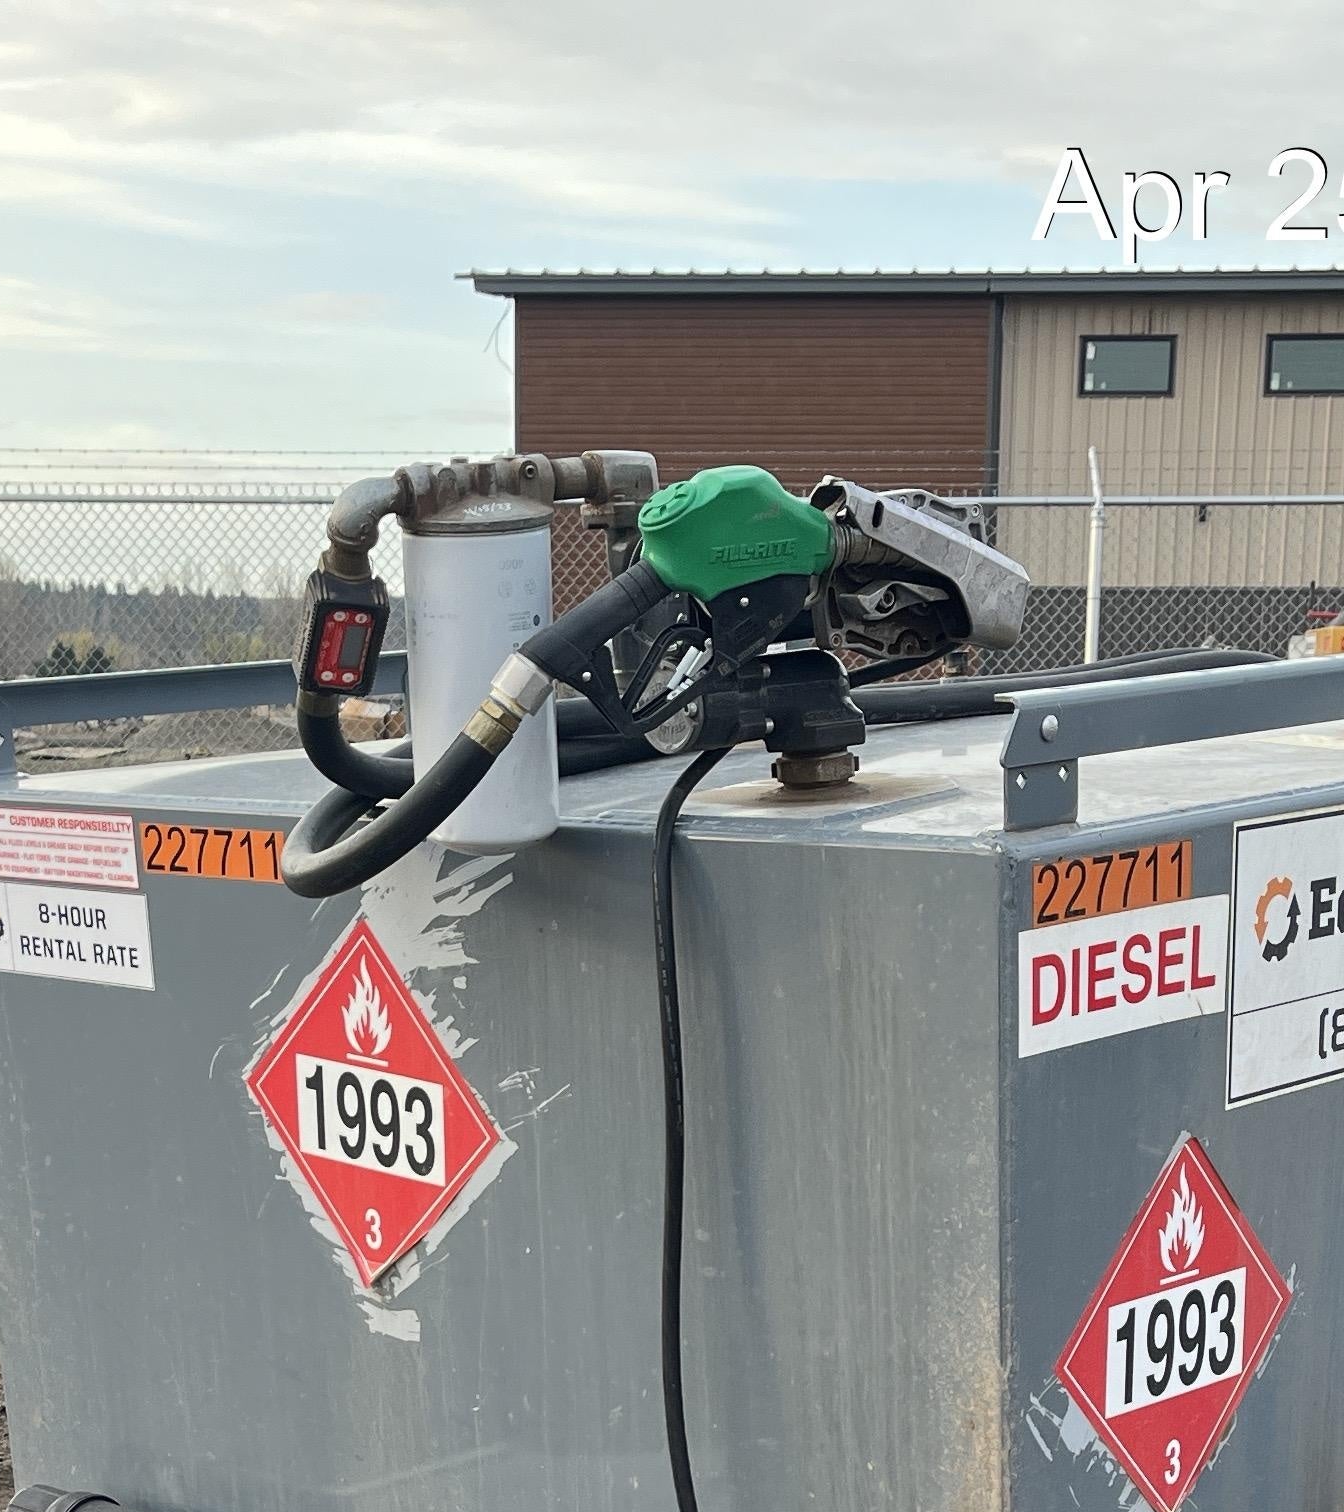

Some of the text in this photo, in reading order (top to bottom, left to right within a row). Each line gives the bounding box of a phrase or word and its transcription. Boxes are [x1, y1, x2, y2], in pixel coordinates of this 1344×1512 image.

[9, 815, 56, 828] CUSTOMER
[57, 818, 132, 834] RESPONSIBILITY
[144, 824, 280, 880] 227711
[1037, 841, 1184, 924] 227711
[38, 902, 107, 930] 8-HOUR
[19, 935, 139, 968] RENTAL RATE
[1032, 925, 1216, 1026] DIESEL
[305, 1065, 436, 1177] 1993
[365, 1208, 383, 1250] 3
[1116, 1279, 1237, 1404] 1993
[1164, 1438, 1181, 1485] 3
